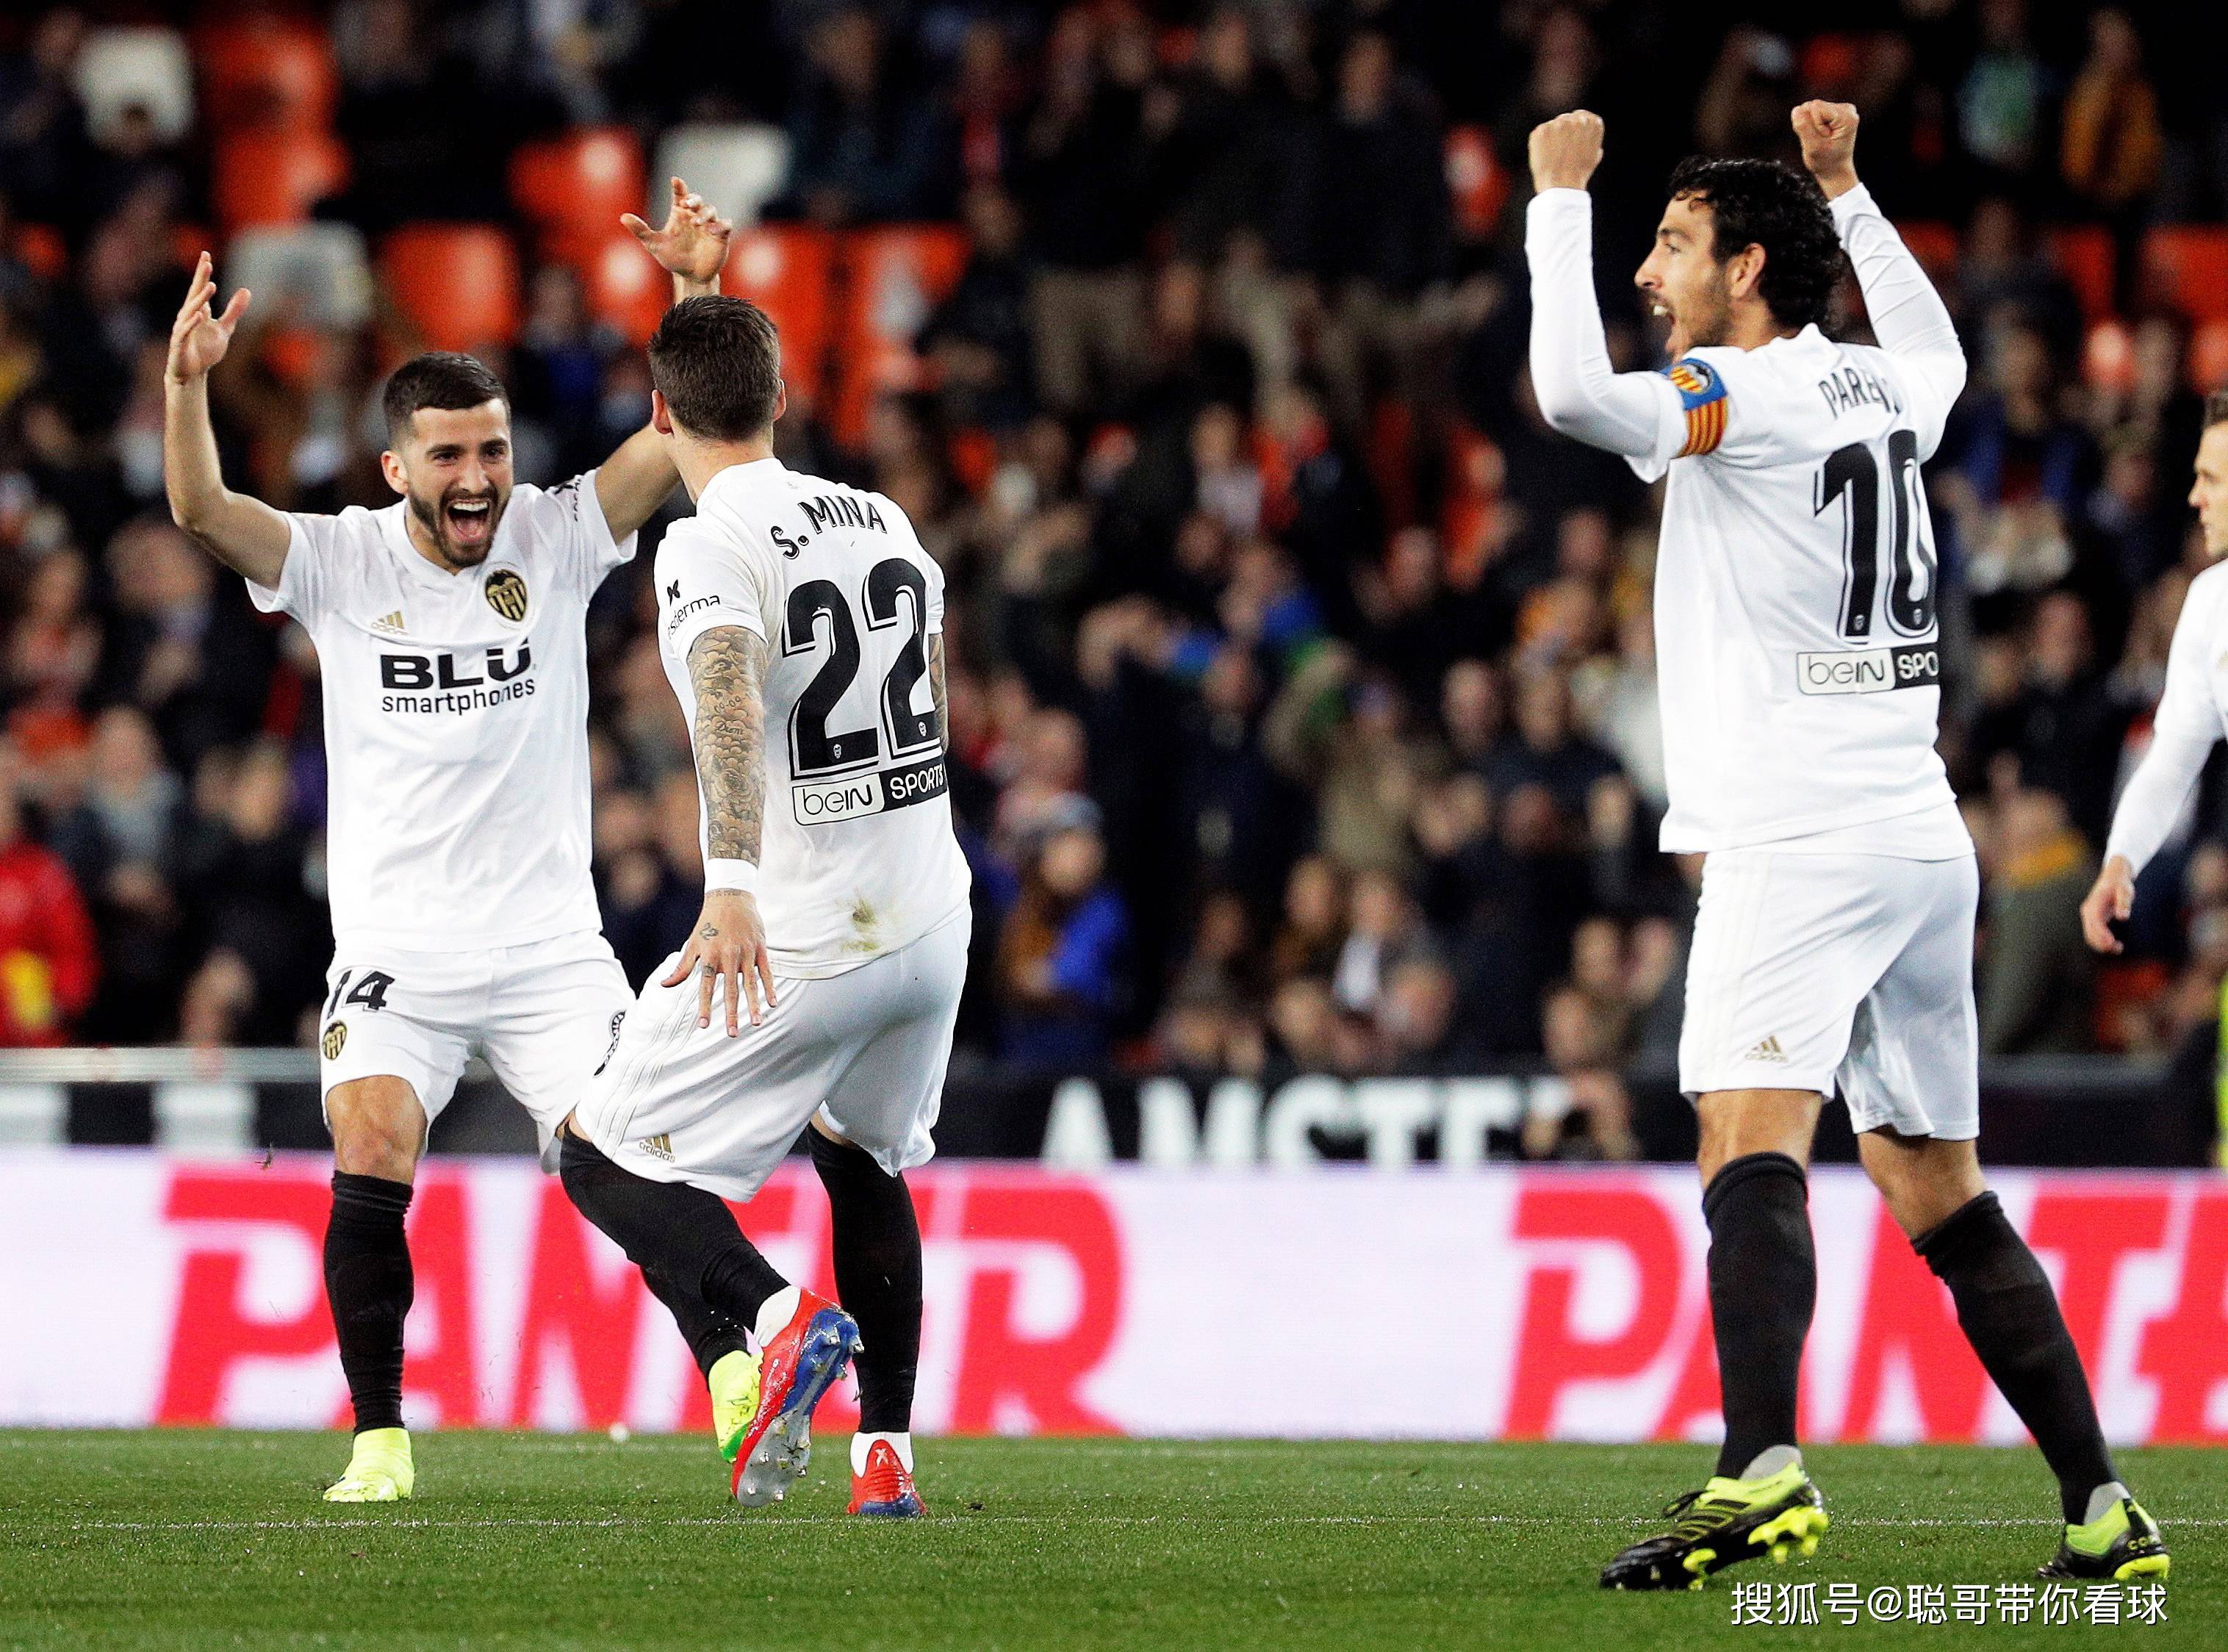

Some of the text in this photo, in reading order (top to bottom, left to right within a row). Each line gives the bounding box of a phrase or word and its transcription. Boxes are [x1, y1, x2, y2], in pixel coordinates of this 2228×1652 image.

[771, 495, 888, 559] S. MINA
[1815, 429, 1938, 644] 10
[667, 595, 721, 640] sderma
[781, 558, 942, 781] 22
[382, 678, 536, 716] smartphones
[890, 763, 944, 800] SPORTS
[327, 969, 395, 1013] 14
